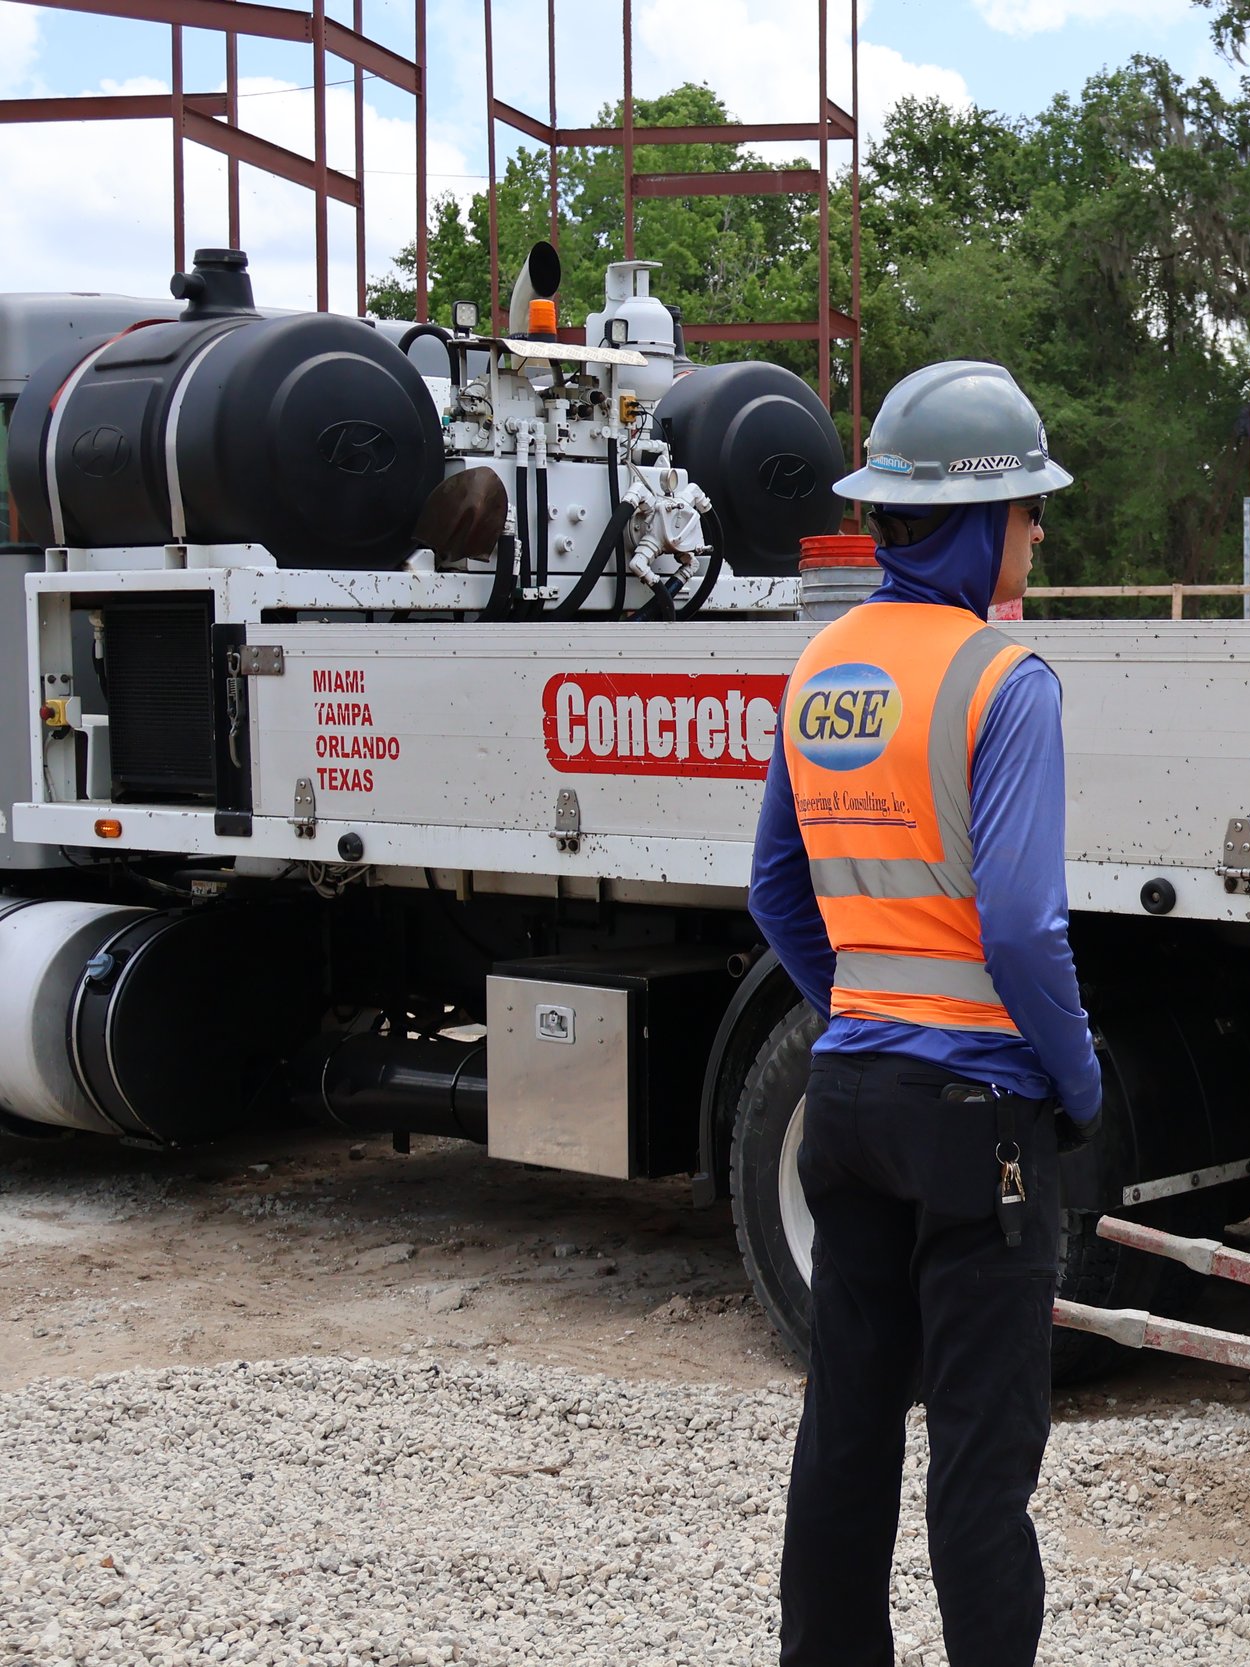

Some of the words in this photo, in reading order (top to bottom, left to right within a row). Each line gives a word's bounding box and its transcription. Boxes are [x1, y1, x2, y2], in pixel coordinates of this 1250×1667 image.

[950, 456, 1021, 472] DAIWA
[313, 669, 365, 694] MIAMI
[314, 702, 374, 727] TAMPA
[556, 681, 778, 762] Concrete
[799, 690, 890, 740] GSE
[315, 734, 400, 761] ORLANDO
[316, 767, 374, 793] TEXAS
[833, 790, 840, 811] &
[842, 790, 891, 817] Consulting,
[892, 791, 911, 814] Inc.
